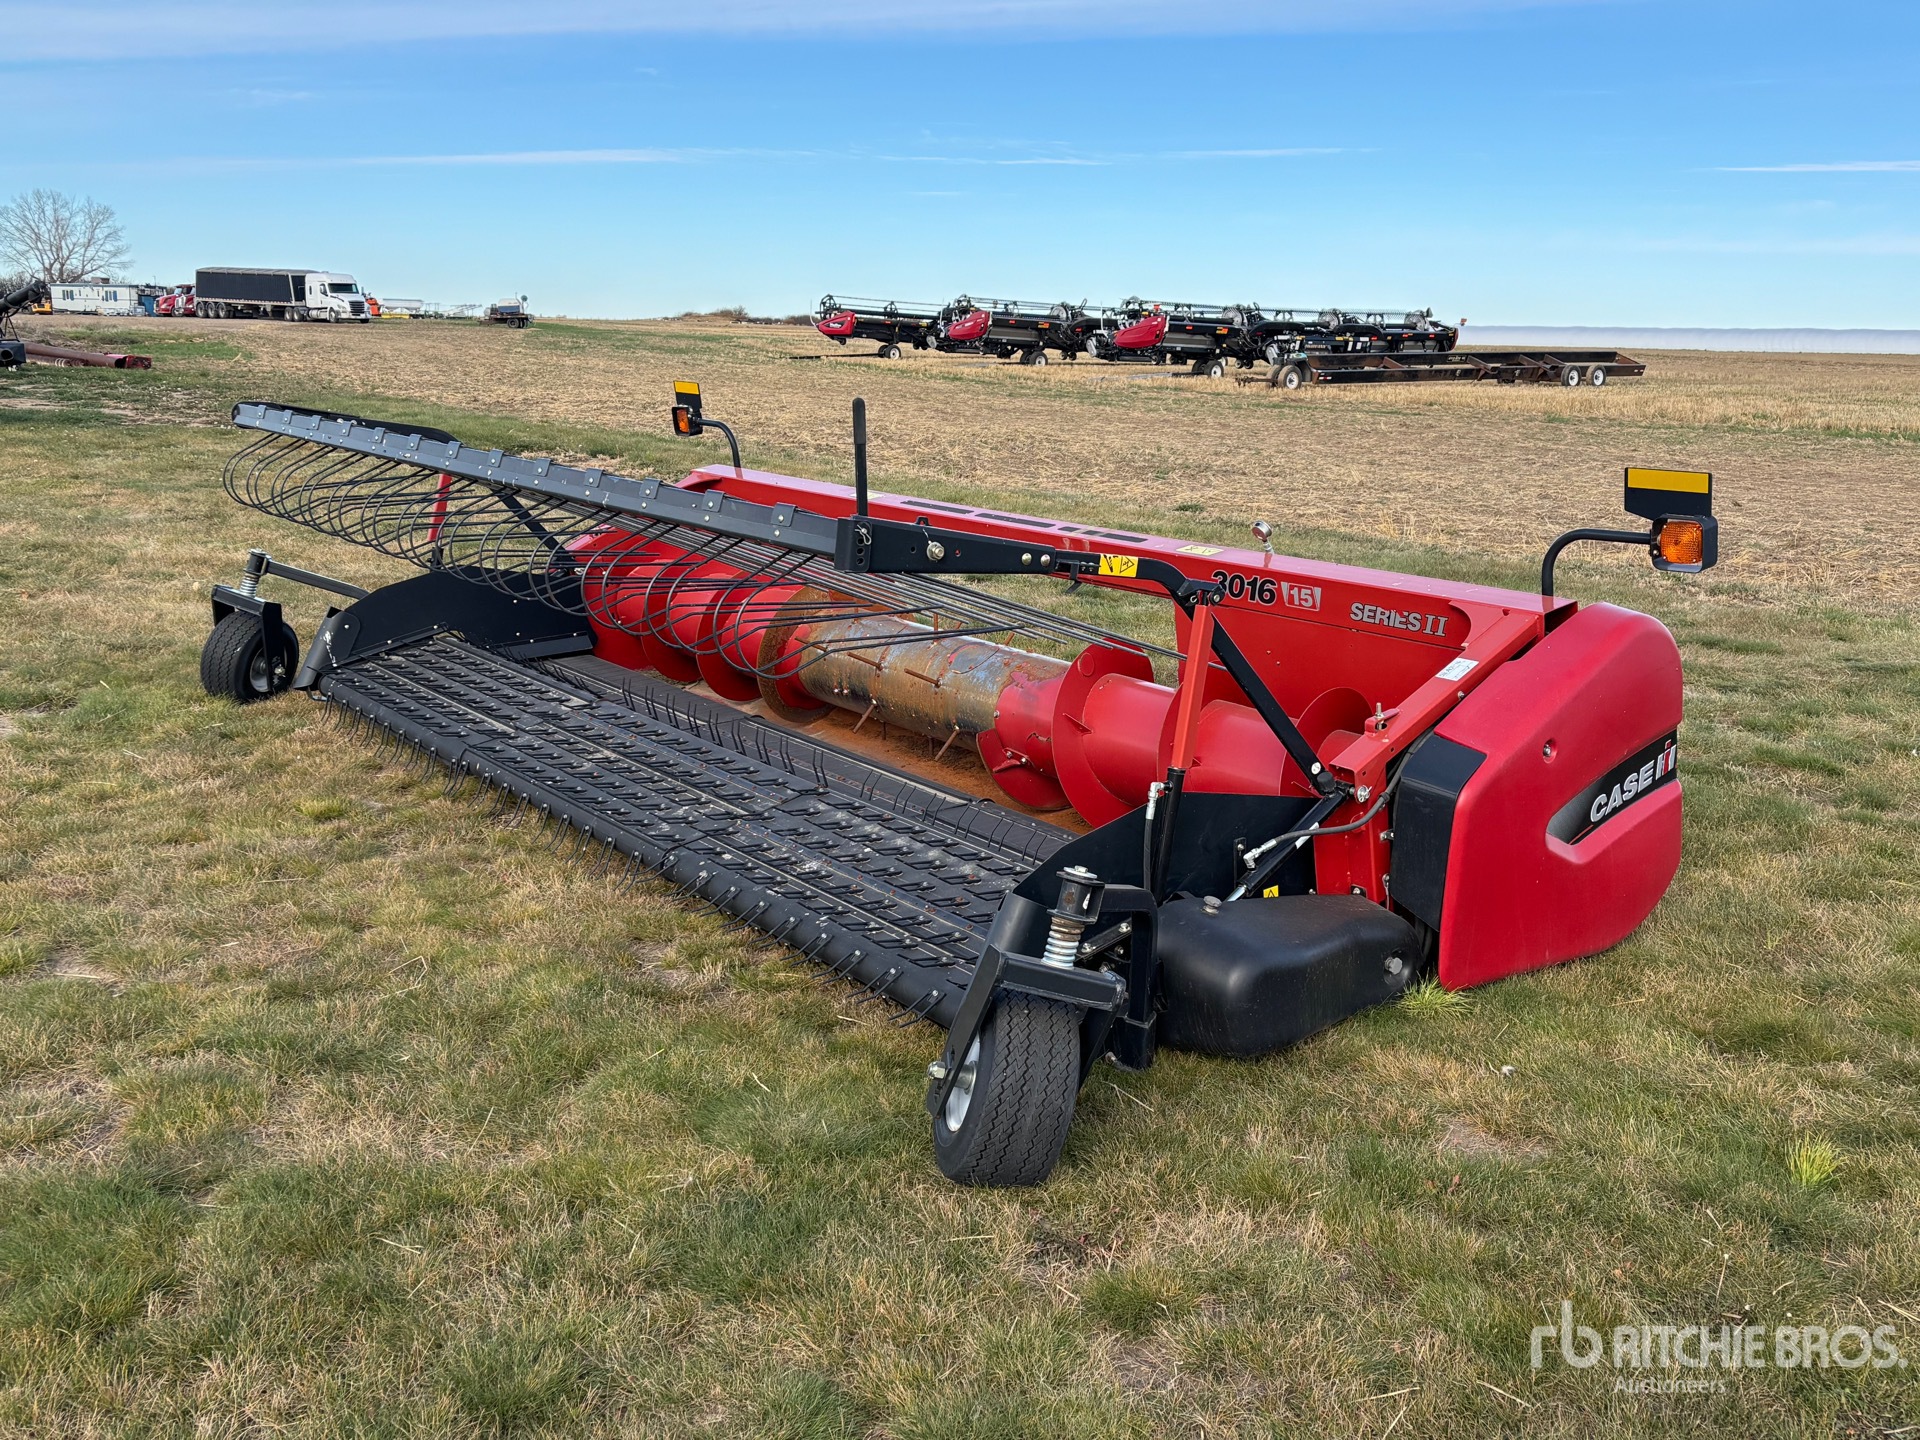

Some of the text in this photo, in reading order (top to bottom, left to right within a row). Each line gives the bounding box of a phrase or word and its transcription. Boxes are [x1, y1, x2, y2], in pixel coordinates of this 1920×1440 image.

[1212, 570, 1313, 607] 3016 15
[1349, 602, 1449, 636] SERIES II
[1590, 760, 1655, 823] CASE
